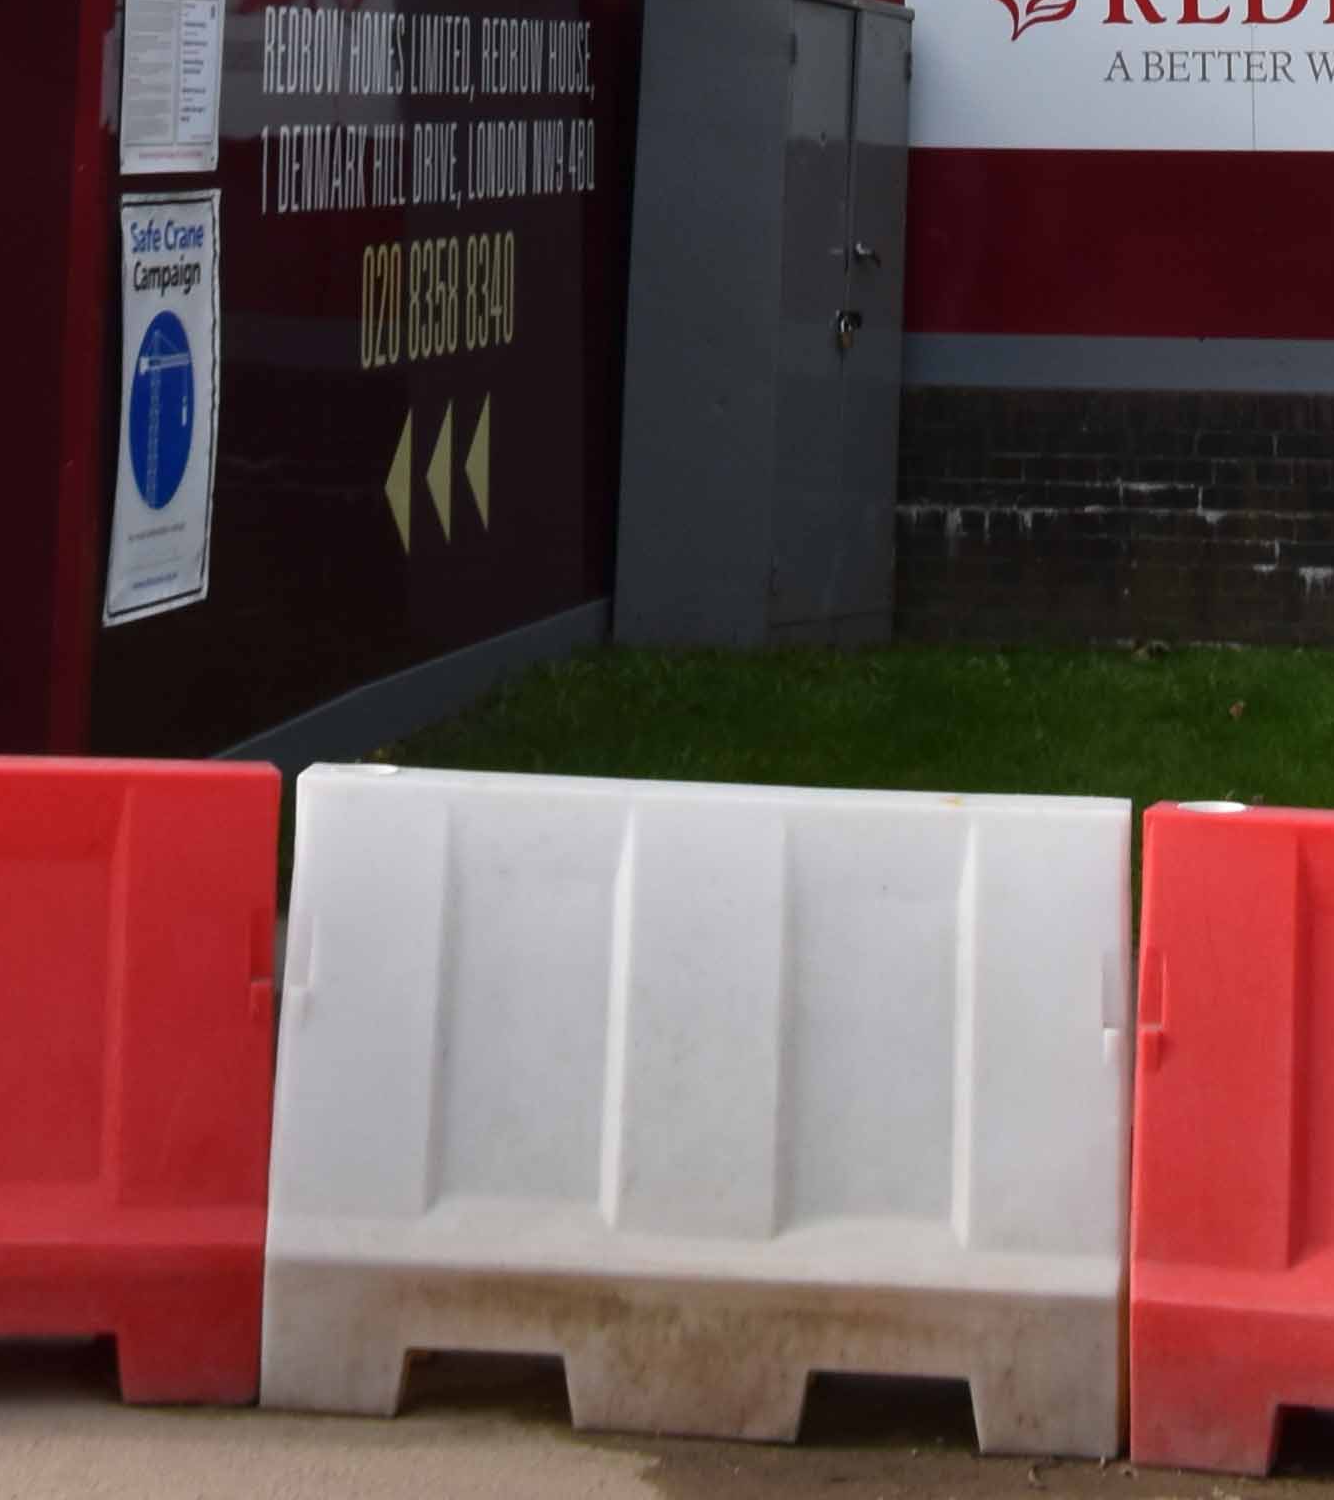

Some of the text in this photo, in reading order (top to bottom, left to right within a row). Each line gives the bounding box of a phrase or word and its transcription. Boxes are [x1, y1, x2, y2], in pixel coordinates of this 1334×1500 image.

[263, 6, 345, 93] REDROW
[349, 12, 405, 94] HOMES
[411, 14, 474, 102] LIMITED,
[481, 17, 543, 93] REDROW
[549, 20, 595, 100] HOUSE,
[1104, 51, 1133, 83] A
[1142, 51, 1295, 84] BETTER
[278, 124, 367, 213] DENMARK
[373, 123, 405, 208] HILL
[412, 122, 462, 209] DRIVE,
[468, 120, 527, 200] LONDON
[533, 119, 563, 194] NW9
[130, 218, 203, 252] Safe Crane
[133, 255, 200, 297] Campaign
[361, 230, 514, 370] 020 8358 8340
